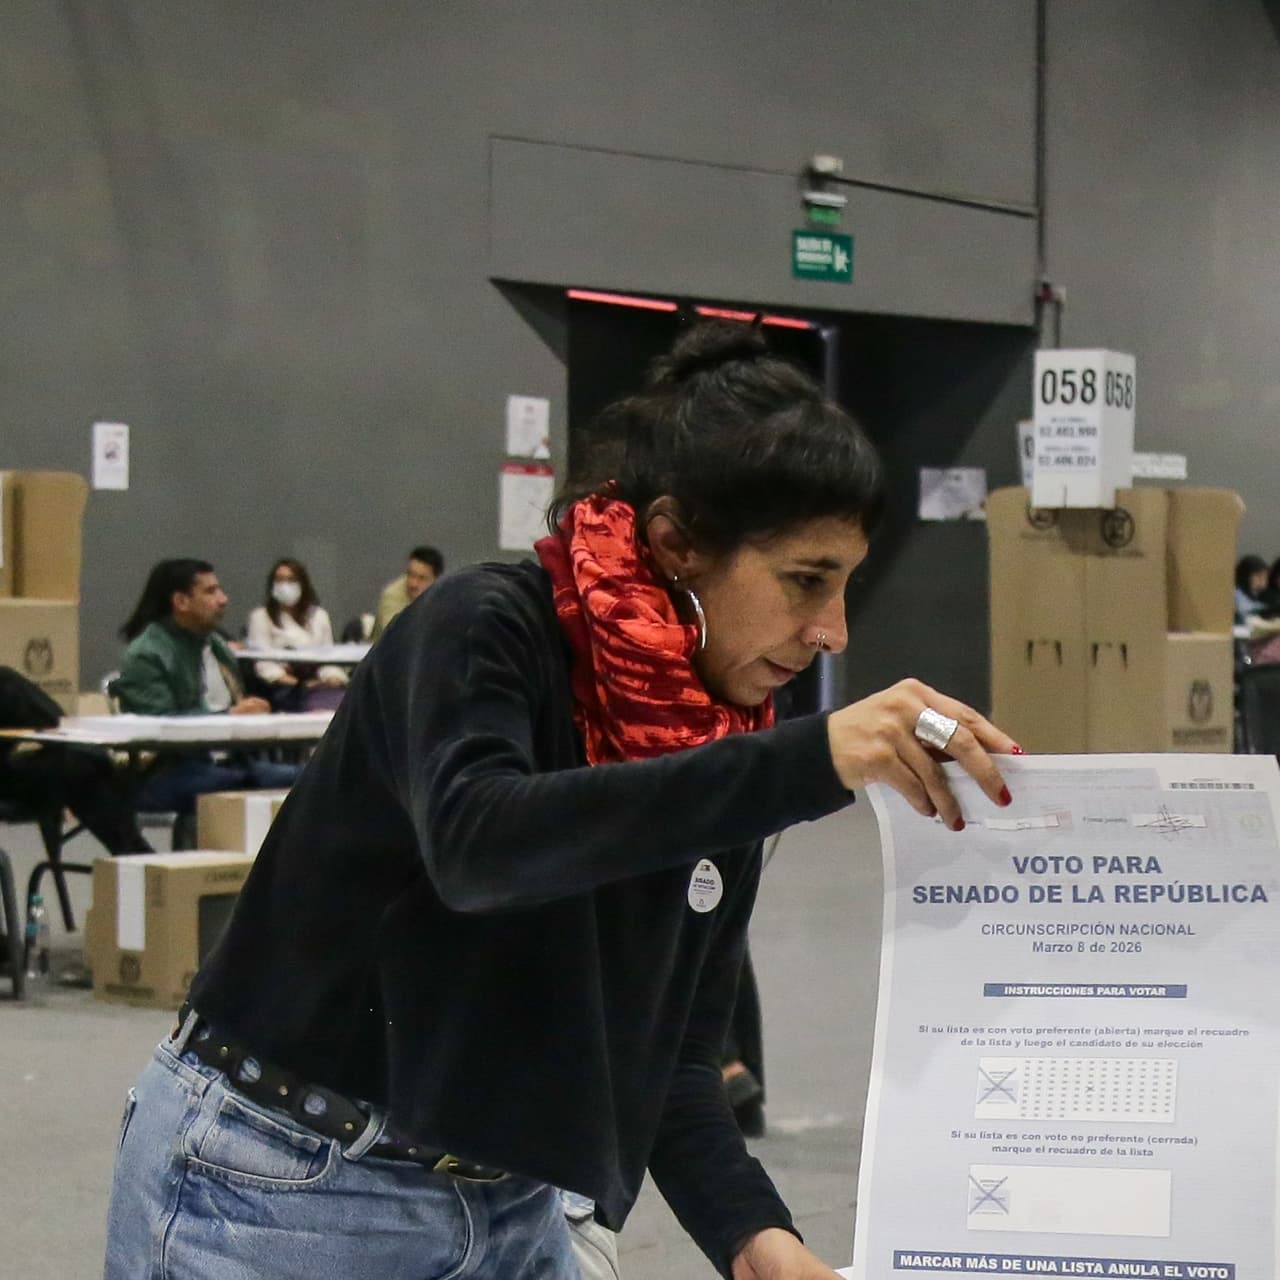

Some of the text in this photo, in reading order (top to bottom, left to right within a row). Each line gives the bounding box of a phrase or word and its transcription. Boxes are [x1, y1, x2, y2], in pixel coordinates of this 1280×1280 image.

[1041, 368, 1097, 405] 058
[1105, 370, 1133, 410] 058
[1012, 855, 1163, 875] VOTO PARA
[912, 879, 1269, 904] SENADO DE LA REPÚBLICA
[981, 921, 1196, 937] CIRCUNSCRIPCIÓN NACIONAL
[1032, 941, 1143, 954] Marzo 8 de 2026
[1004, 985, 1166, 997] INSTRUCCIONES PARA VOTAR
[947, 1025, 969, 1034] lista
[988, 1026, 1007, 1035] con
[1010, 1026, 1033, 1035] voto
[960, 1038, 973, 1047] de
[989, 1038, 1012, 1047] lista
[1024, 1039, 1053, 1049] luego
[1070, 1039, 1122, 1049] candidato
[979, 1131, 1003, 1140] lista
[1021, 1133, 1041, 1141] con
[1044, 1134, 1068, 1142] voto
[1071, 1135, 1084, 1143] no
[1129, 1148, 1154, 1157] lista
[900, 1255, 1229, 1280] MARCAR MÁS DE UNA LISTA ANULA EL VOTO
